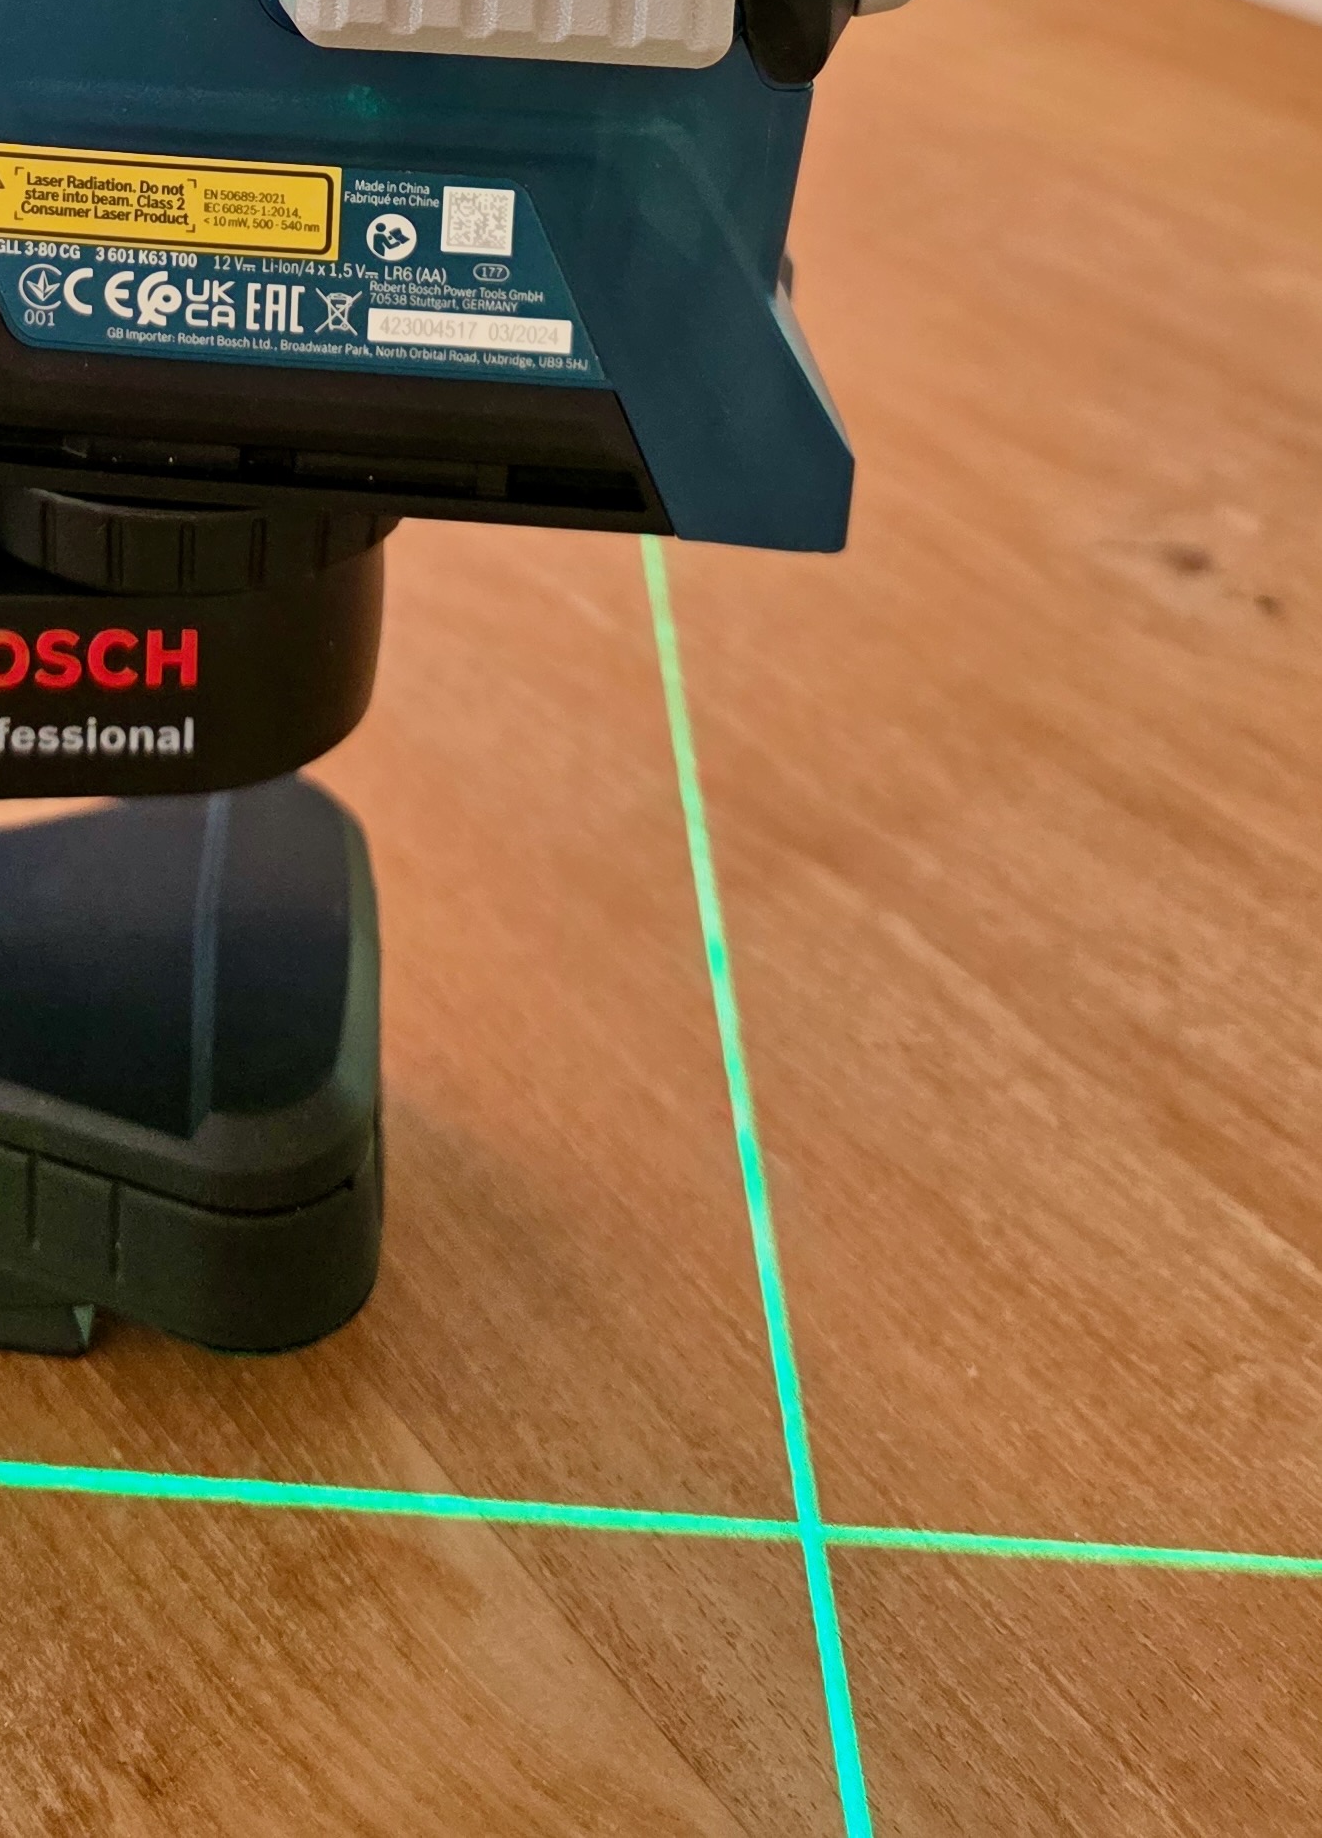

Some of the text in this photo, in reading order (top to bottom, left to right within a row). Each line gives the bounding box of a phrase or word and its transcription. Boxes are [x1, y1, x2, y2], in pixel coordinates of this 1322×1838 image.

[27, 172, 185, 196] Laser Radiation. Do not
[355, 180, 430, 195] Made in China
[25, 188, 185, 210] stare into beam. Class 2
[204, 189, 286, 204] EN 50689:2021
[344, 192, 440, 208] Fabriqué en Chine
[21, 200, 189, 225] Consumer Laser Product
[204, 202, 221, 213] IEC
[213, 216, 227, 227] 10
[228, 217, 251, 230] mW,
[252, 218, 274, 230] 500
[281, 220, 303, 232] 540
[304, 223, 320, 233] nm
[60, 244, 80, 259] CG
[96, 247, 197, 267] 3 601 K63 T00
[214, 255, 230, 270] 12
[317, 264, 326, 276] x
[329, 263, 353, 278] 1,5
[384, 265, 413, 281] LR6
[416, 267, 447, 285] (AA)
[481, 266, 503, 278] 177
[186, 278, 236, 303] UK
[370, 281, 543, 302] Robert Bosch Power Tools GmbH
[370, 293, 518, 312] 70538 Stuttgart, GERMANY
[24, 309, 55, 326] 001
[185, 303, 236, 329] CA
[379, 315, 559, 345] 423004517 03/2024
[107, 326, 124, 339] GB
[126, 328, 175, 345] Importer:
[178, 332, 215, 346] Robert
[217, 334, 251, 348] Bosch
[280, 340, 342, 354] Broadwater
[345, 344, 372, 357] Park,
[376, 345, 407, 359] North
[409, 347, 446, 361] Orbital
[449, 350, 480, 363] Road,
[483, 352, 536, 368] Uxbridge,
[539, 356, 563, 369] UB9
[565, 358, 589, 370] 5HJ
